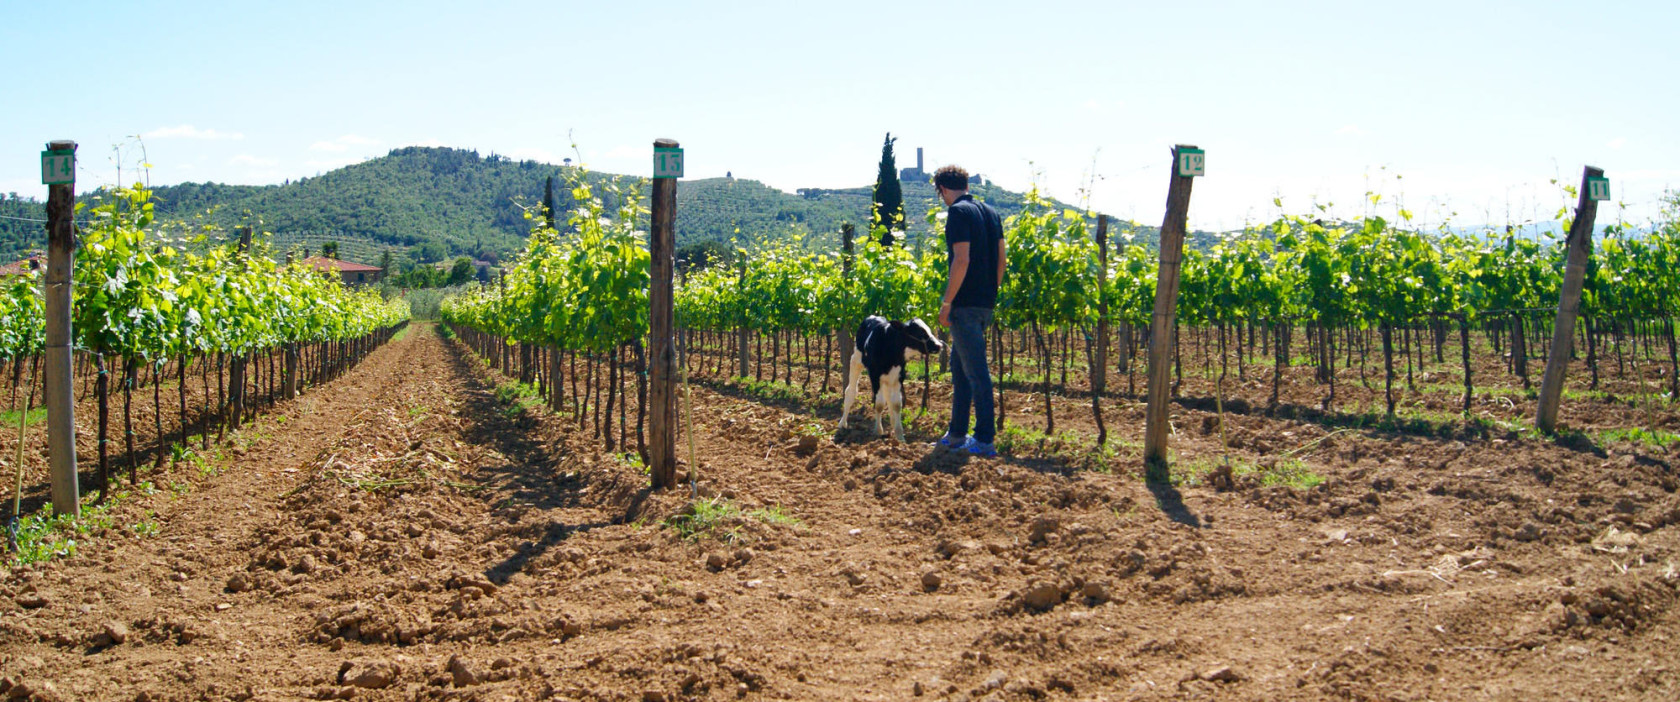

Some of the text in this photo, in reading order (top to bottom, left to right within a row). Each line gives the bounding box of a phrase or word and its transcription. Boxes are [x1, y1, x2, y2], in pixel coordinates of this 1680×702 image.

[45, 157, 72, 177] 14
[1182, 155, 1202, 170] 12
[1593, 182, 1607, 196] 11
